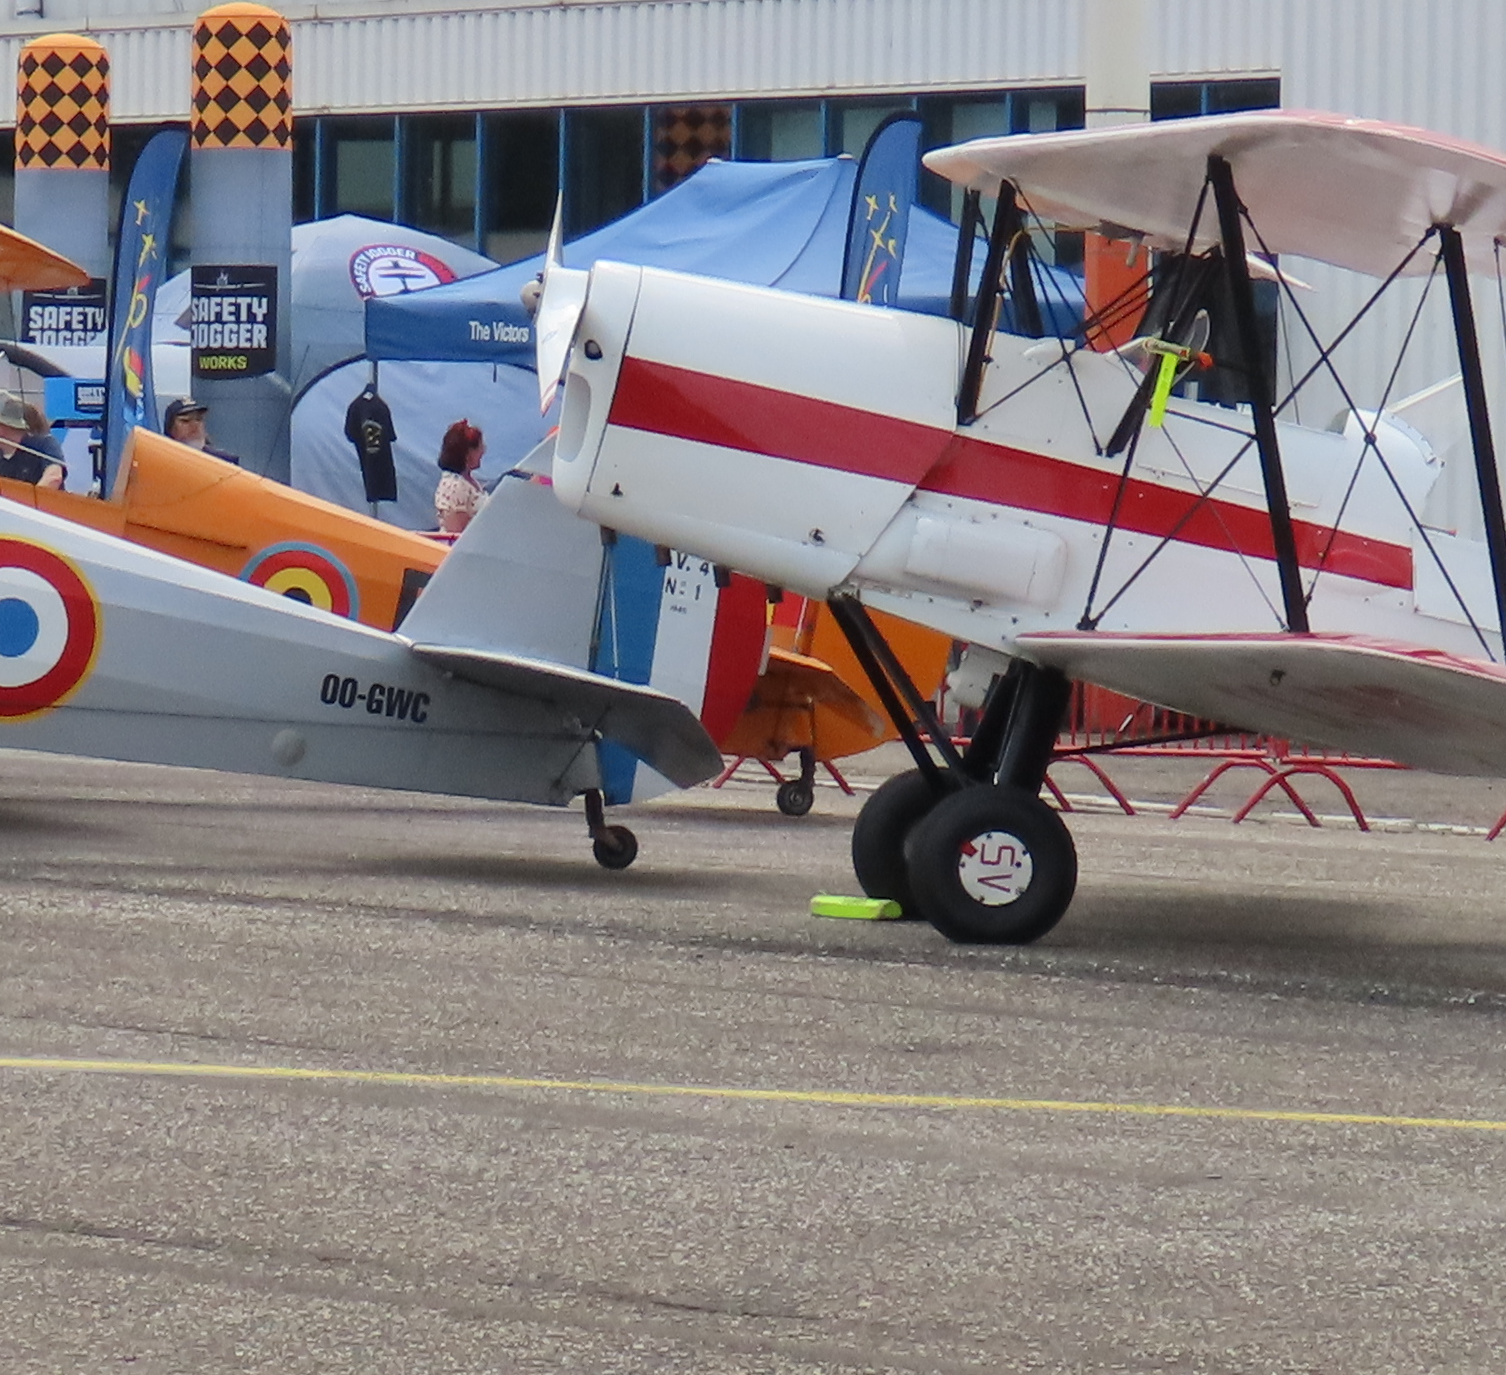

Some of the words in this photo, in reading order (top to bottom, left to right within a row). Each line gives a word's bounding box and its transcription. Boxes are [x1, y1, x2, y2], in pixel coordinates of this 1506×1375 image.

[29, 306, 104, 330] SAFETY
[191, 296, 268, 322] SAFETY
[191, 323, 268, 349] JOGGER
[469, 321, 490, 340] The
[493, 322, 529, 342] Victors
[199, 355, 248, 370] WORKS
[320, 674, 431, 723] OO-GWC
